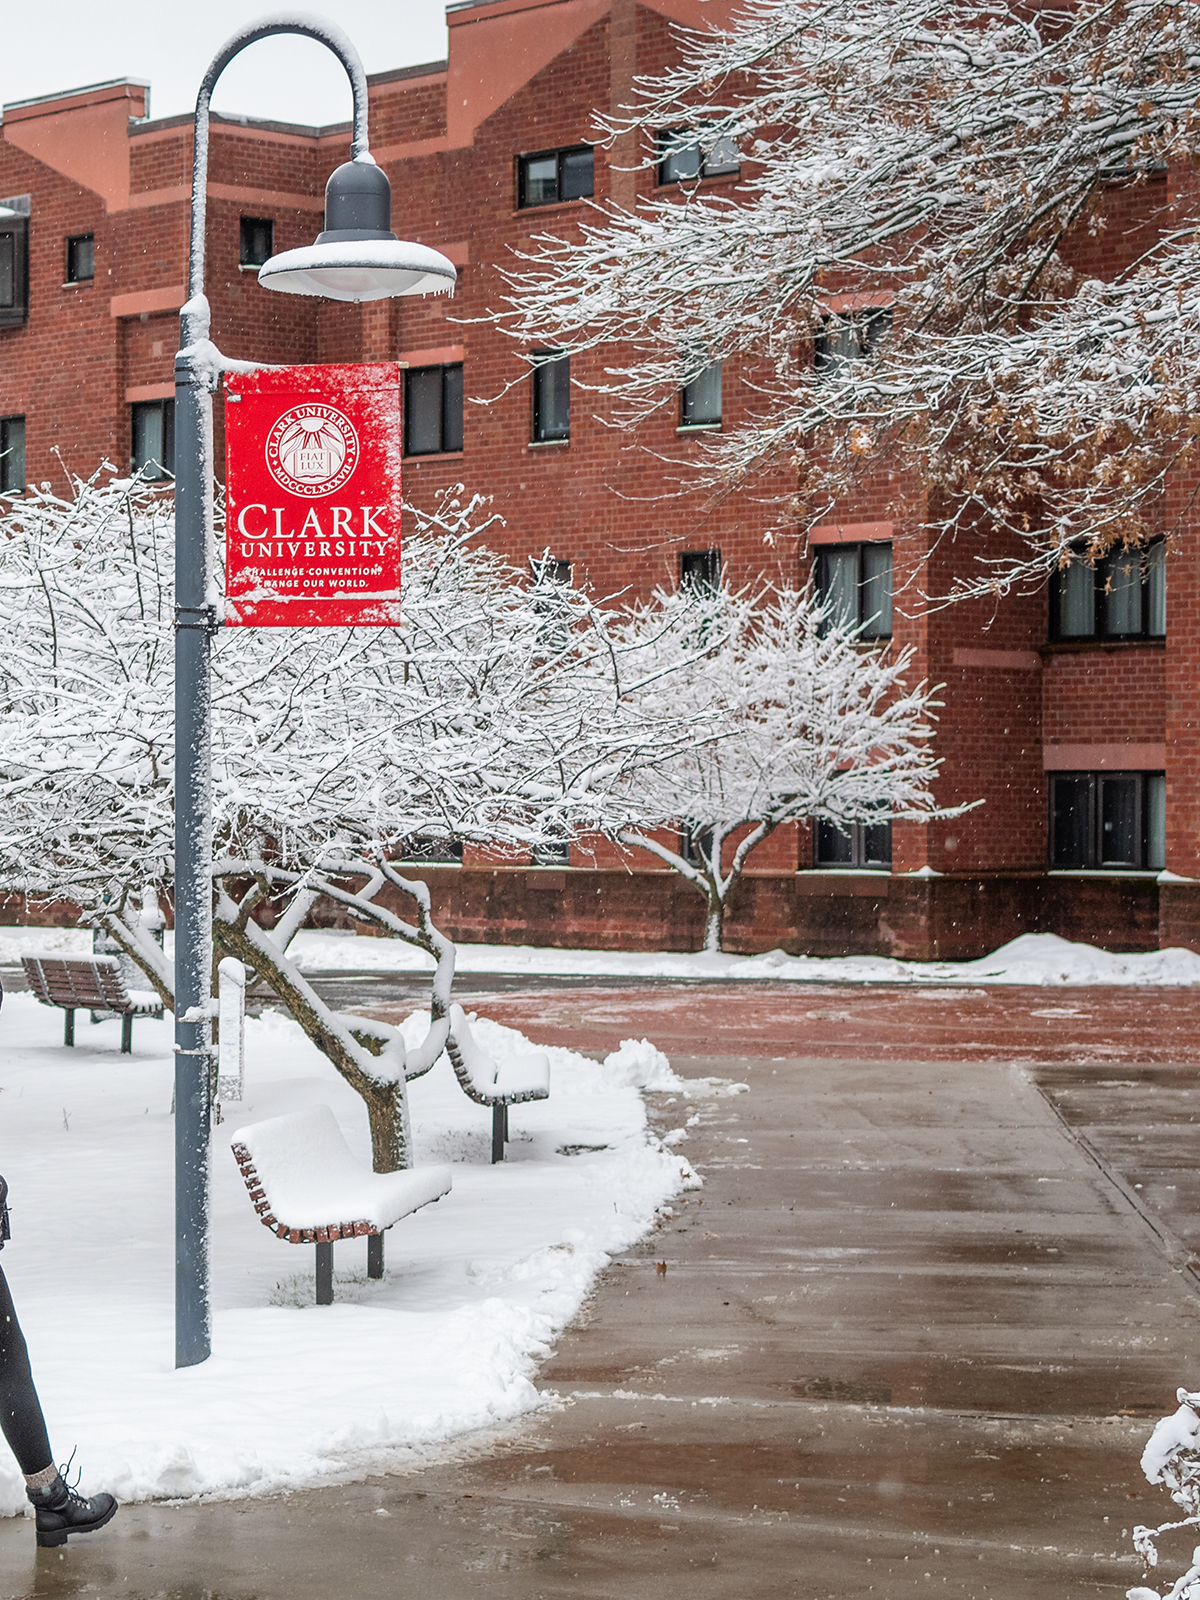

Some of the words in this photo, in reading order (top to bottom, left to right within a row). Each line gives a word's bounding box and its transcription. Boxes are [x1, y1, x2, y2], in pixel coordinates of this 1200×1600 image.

[269, 414, 296, 457] CLARK
[295, 407, 356, 455] UNIVERSITY
[300, 452, 325, 460] FIAT
[274, 465, 352, 494] MDCCCLXXXVII
[237, 504, 388, 539] CLARK
[241, 541, 388, 558] UNIVERSITY
[302, 579, 324, 588] OUR
[328, 579, 368, 588] WORLD.
